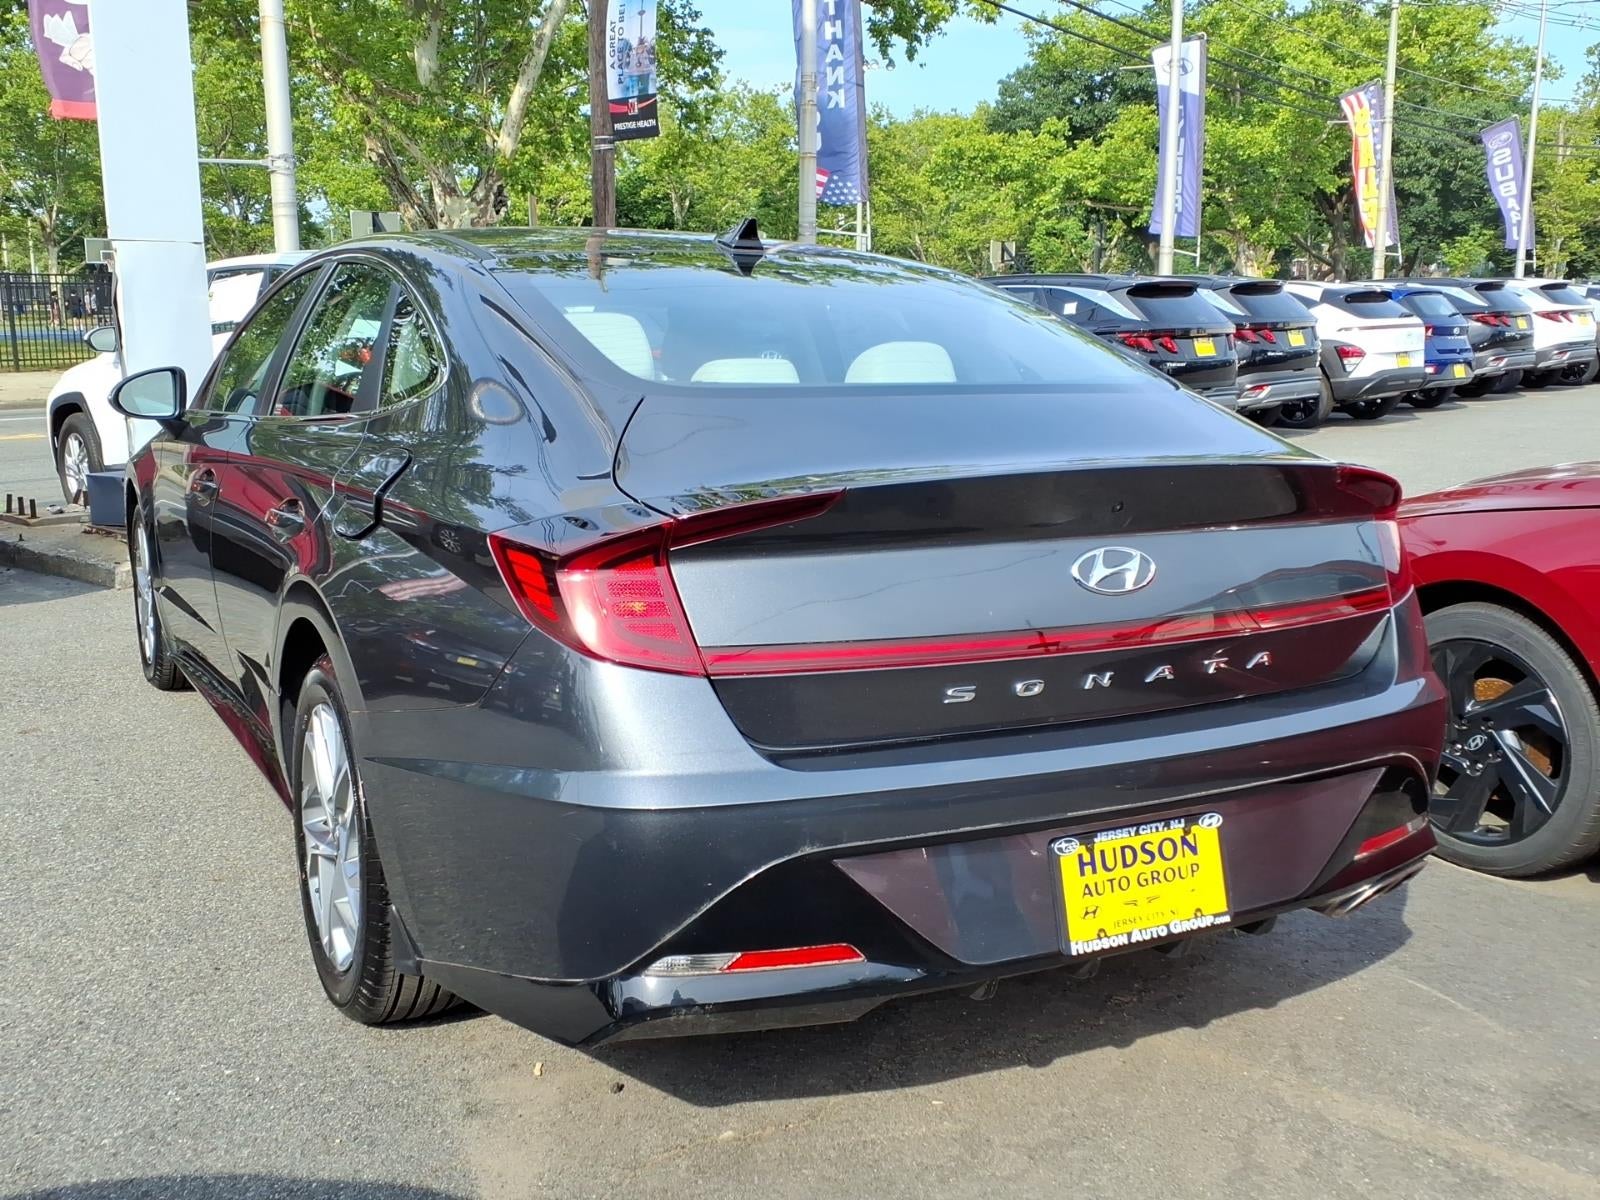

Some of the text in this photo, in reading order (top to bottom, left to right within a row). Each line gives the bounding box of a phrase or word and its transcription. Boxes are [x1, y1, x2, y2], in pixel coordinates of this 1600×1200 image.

[609, 20, 617, 70] A GREAT
[617, 26, 625, 41] TO
[614, 118, 656, 131] PRESTIGE HEALTH
[943, 651, 1273, 704] SONATA
[1094, 827, 1137, 843] JERSEY
[1170, 818, 1186, 829] NJ
[1078, 833, 1198, 877] HUDSON
[1082, 862, 1200, 899] AUTO GROUP
